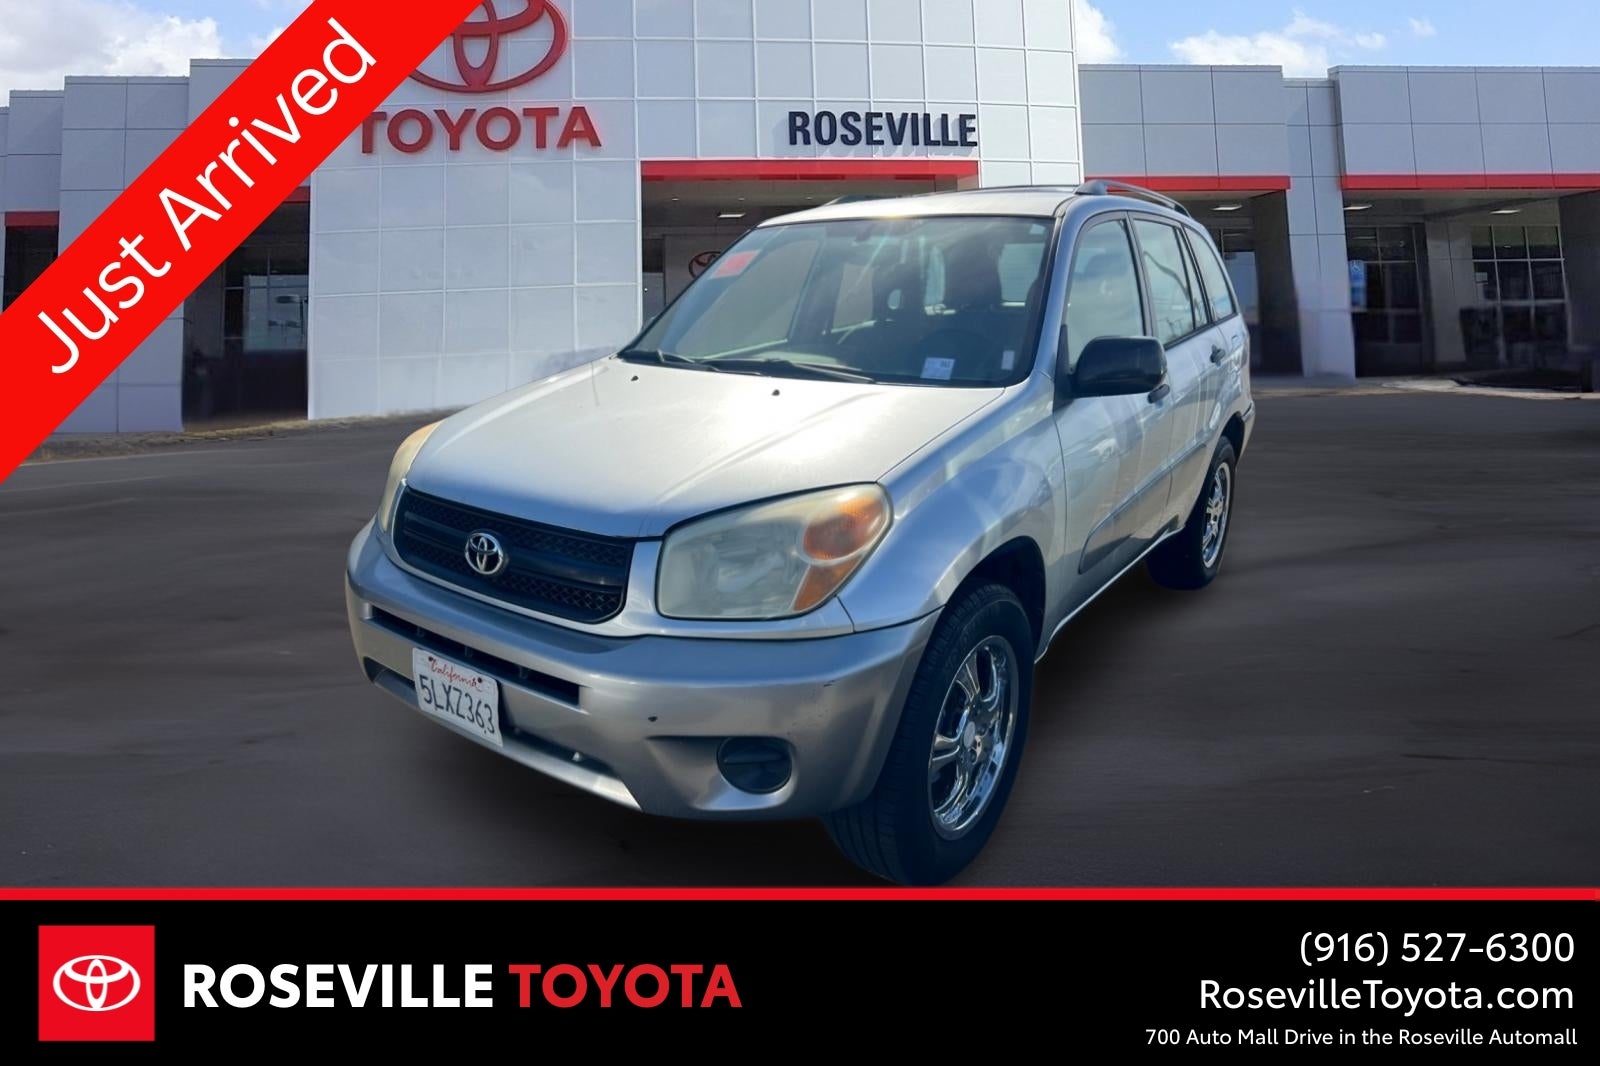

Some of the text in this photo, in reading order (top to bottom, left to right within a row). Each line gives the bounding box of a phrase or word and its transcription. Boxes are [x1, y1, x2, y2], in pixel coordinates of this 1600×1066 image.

[361, 106, 602, 154] TOYOTA
[788, 110, 978, 147] ROSEVILLE
[419, 674, 495, 734] 5LXZ363
